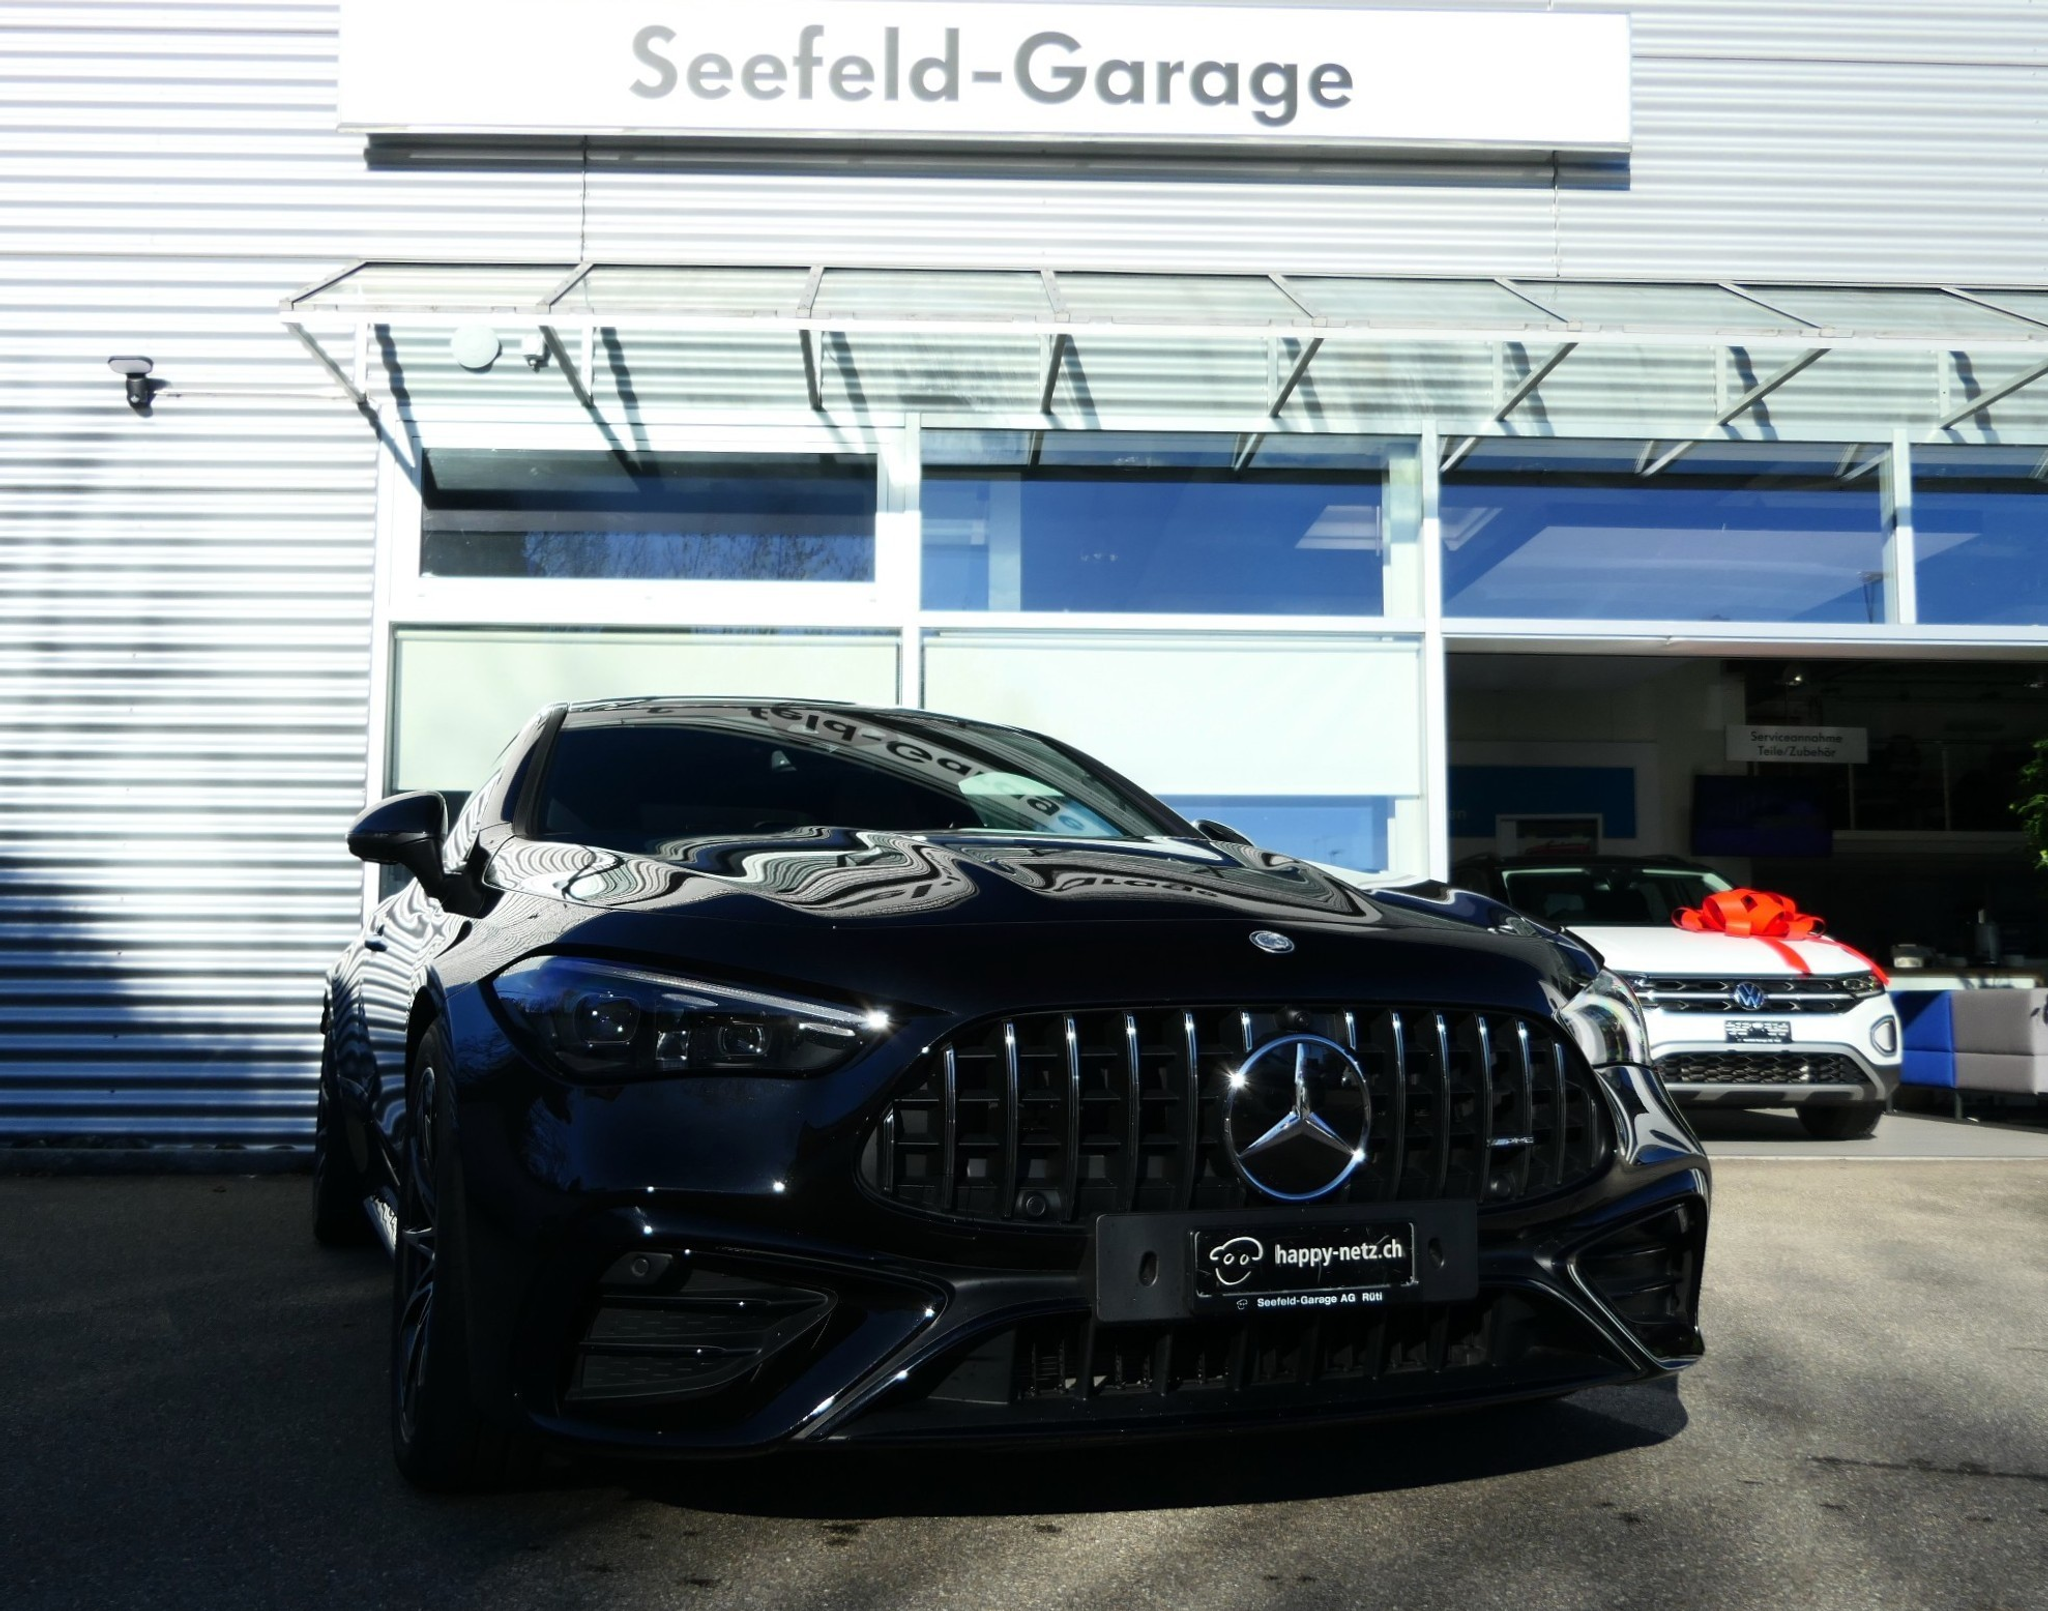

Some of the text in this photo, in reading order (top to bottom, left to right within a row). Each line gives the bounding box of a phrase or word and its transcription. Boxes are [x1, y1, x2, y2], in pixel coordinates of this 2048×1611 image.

[630, 24, 1354, 128] Seefeld-Garage
[1750, 730, 1843, 744] Serviceannahme
[1757, 745, 1836, 758] Teile/Zubehör
[1274, 1238, 1403, 1268] happy-netz.ch
[1257, 1291, 1384, 1308] Seefeld-Garage AG Rüti
